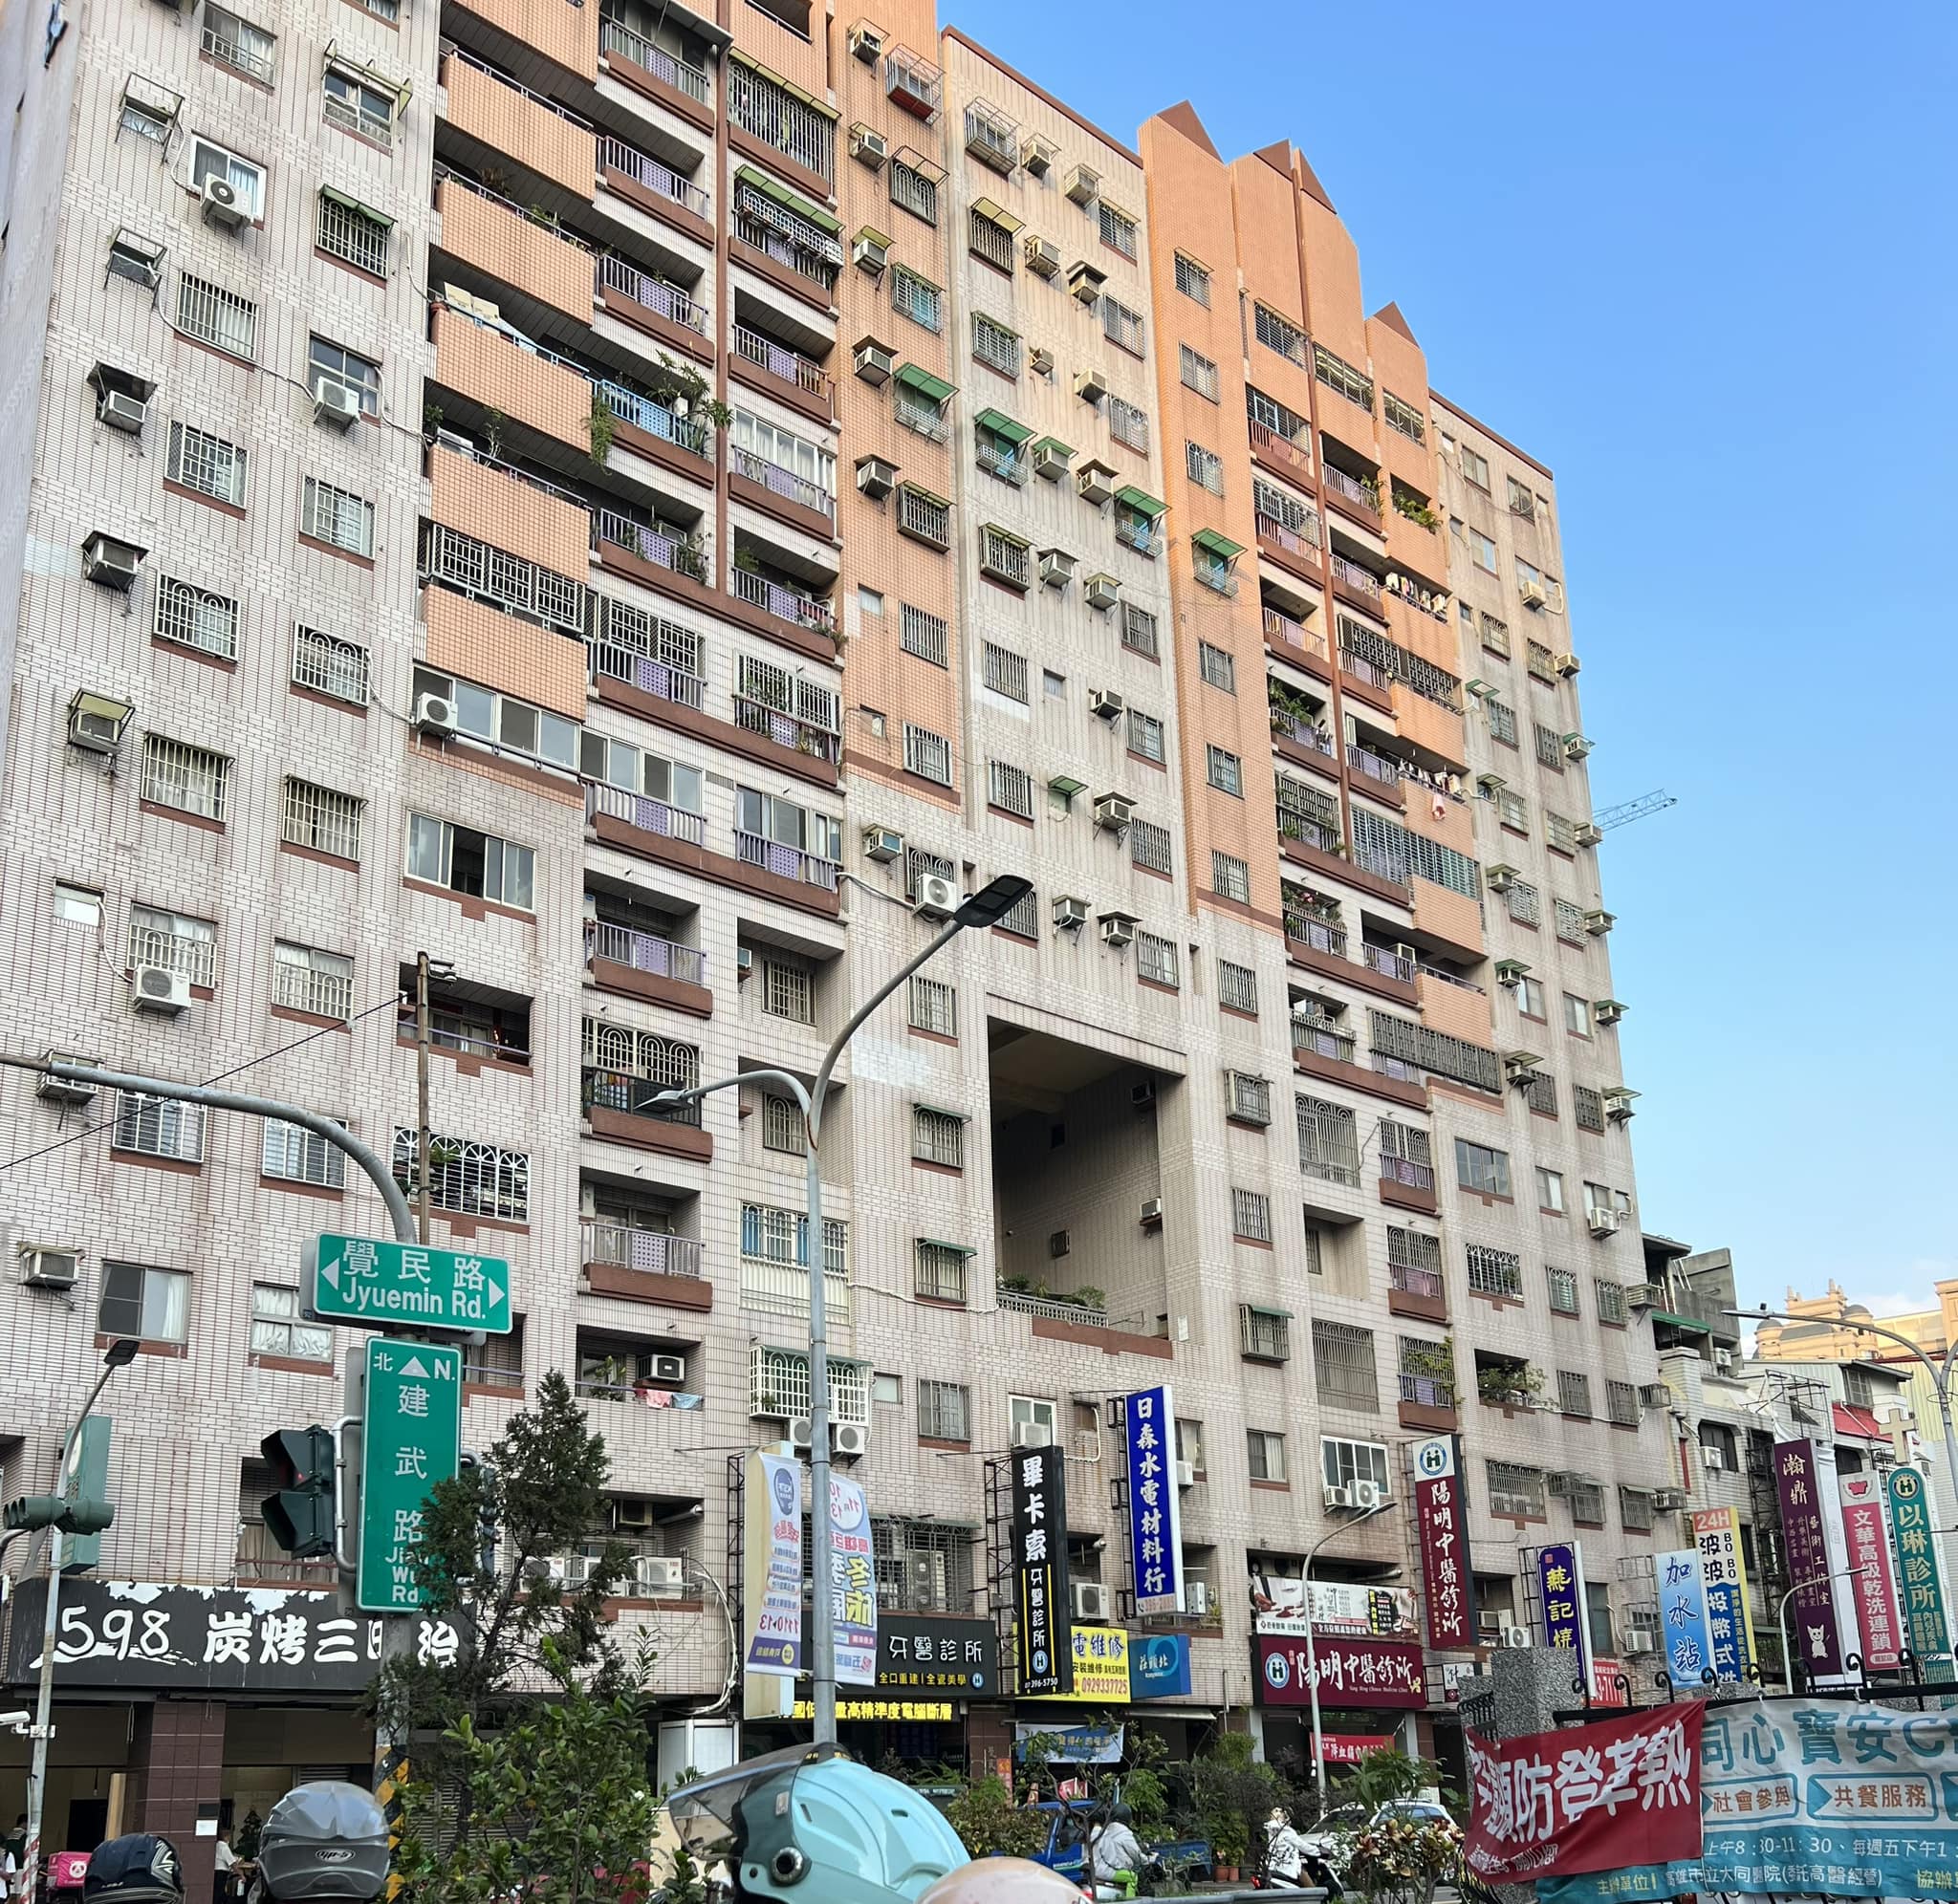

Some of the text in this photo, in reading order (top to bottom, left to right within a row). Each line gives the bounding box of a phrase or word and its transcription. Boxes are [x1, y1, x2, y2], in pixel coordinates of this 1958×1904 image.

[342, 1241, 486, 1291] 覺民路
[342, 1277, 487, 1320] Jyuemin Rd.
[373, 1352, 456, 1381] 北 N.
[393, 1384, 430, 1544] 建武路
[1022, 1455, 1047, 1562] 畢卡索
[1136, 1396, 1166, 1593] 日森水電材料行
[1697, 1511, 1730, 1529] 24H
[1430, 1480, 1464, 1637] 陽明中醫診所
[1898, 1504, 1936, 1610] 以琳診所
[1853, 1509, 1892, 1652] 文華高級乾洗連鎖
[1030, 1568, 1046, 1647] 牙醫診所
[1666, 1556, 1701, 1671] 加水站
[57, 1605, 171, 1661] 598
[889, 1635, 983, 1662] 牙醫診所
[1072, 1632, 1125, 1659] 電維修
[1296, 1651, 1414, 1691] 陽明中醫診所
[779, 1700, 952, 1720] 國低量高精準度電腦斷層
[1712, 1785, 1790, 1813] 社會參與
[1835, 1784, 1927, 1808] 共餐服務
[1917, 1869, 1958, 1889] 協辦
